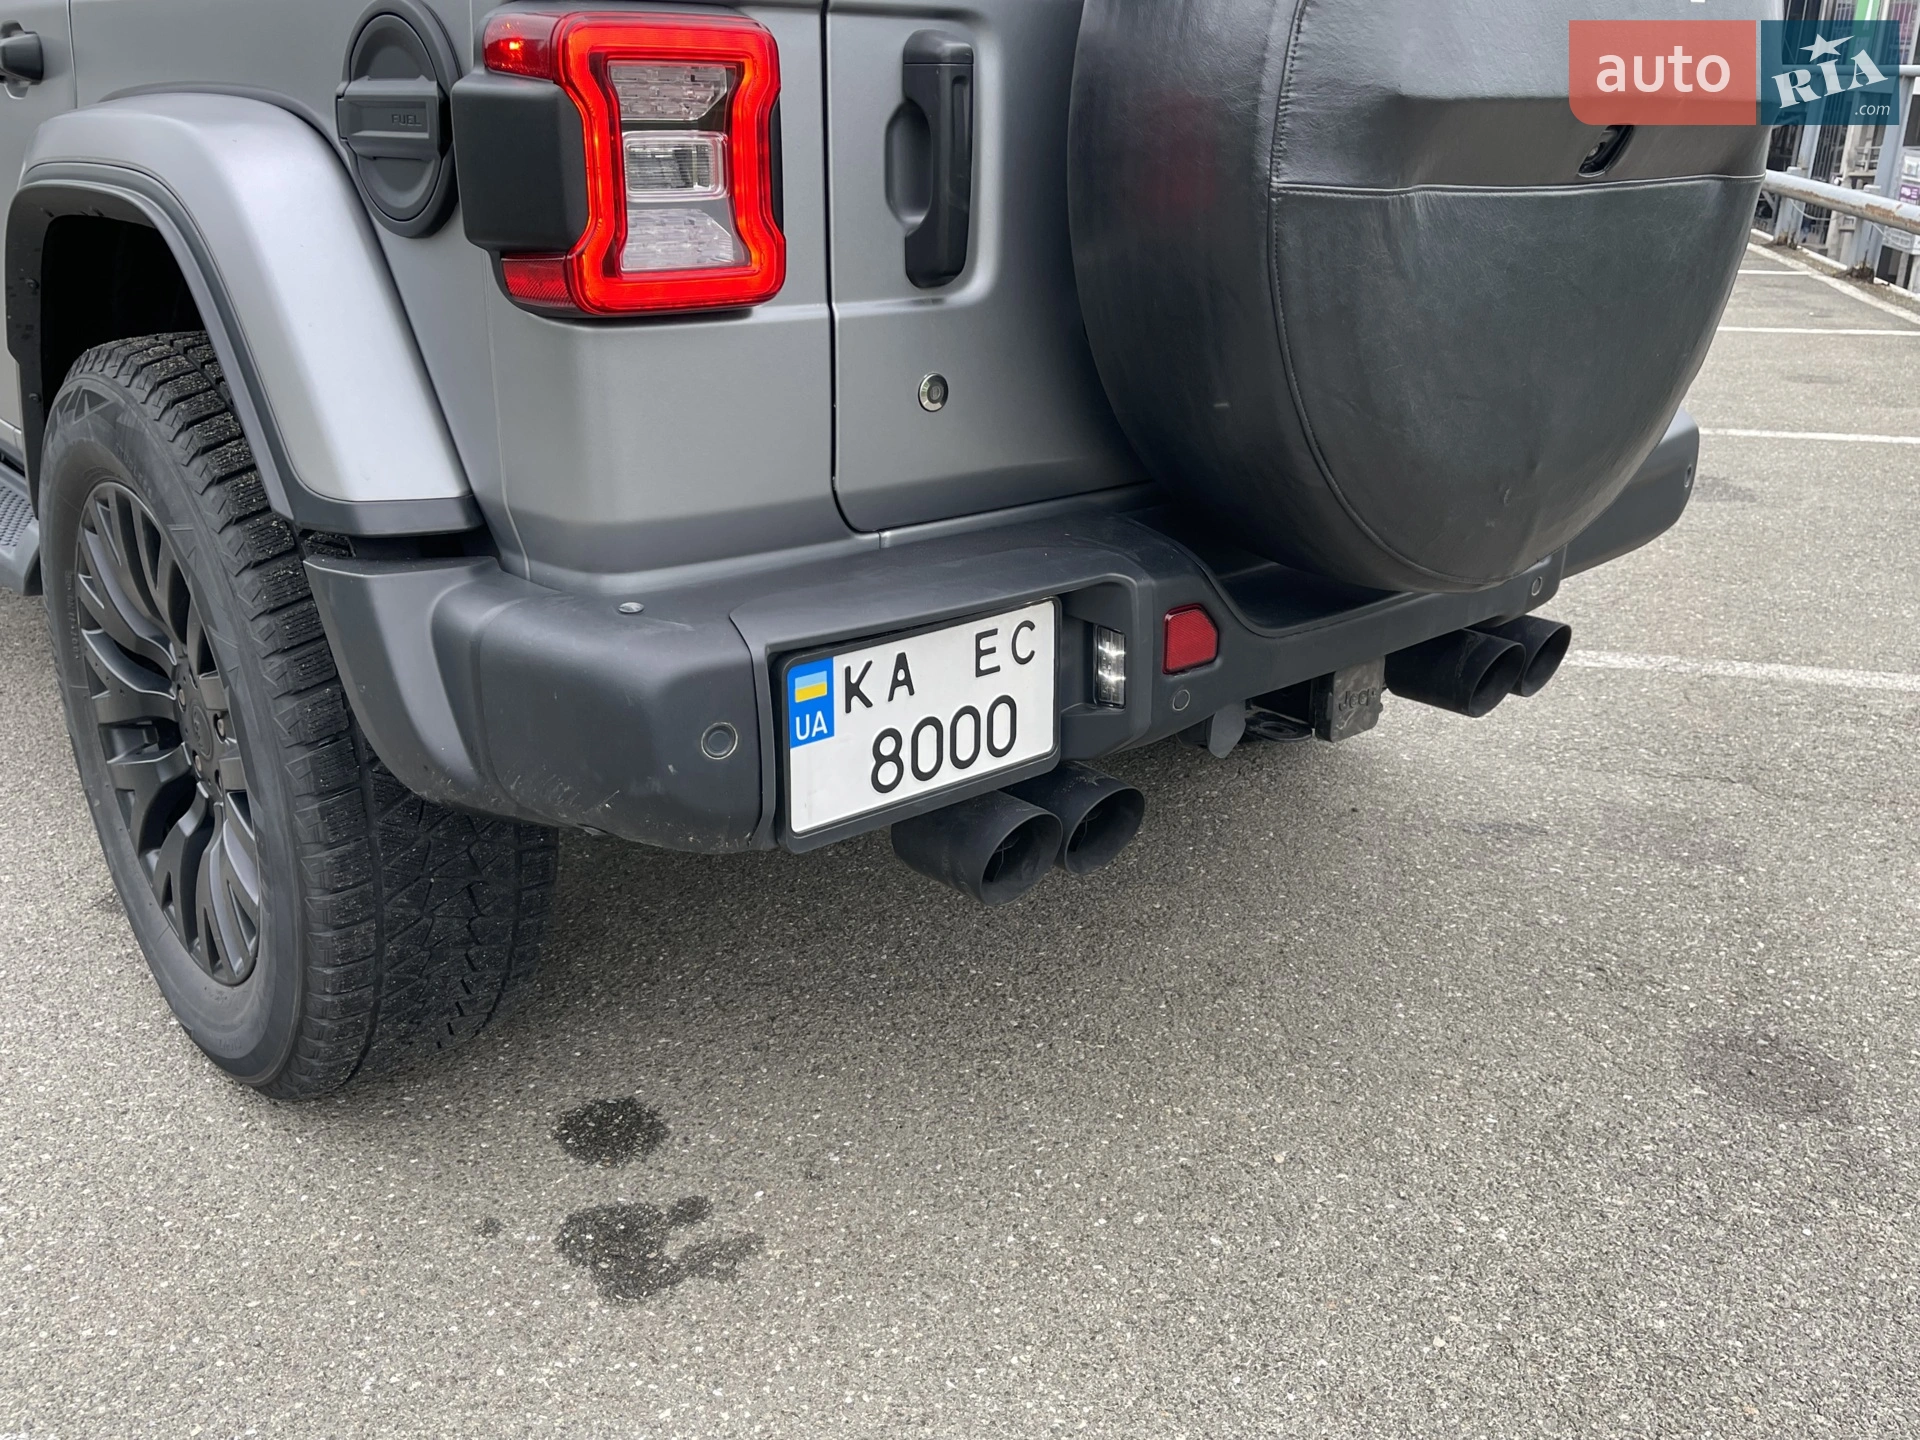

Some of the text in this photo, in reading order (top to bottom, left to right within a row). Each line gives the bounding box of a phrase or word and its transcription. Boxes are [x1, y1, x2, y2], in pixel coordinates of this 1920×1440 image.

[391, 113, 422, 127] FUEL
[844, 620, 1036, 714] KA EC
[795, 710, 828, 740] UA
[871, 694, 1017, 794] 8000
